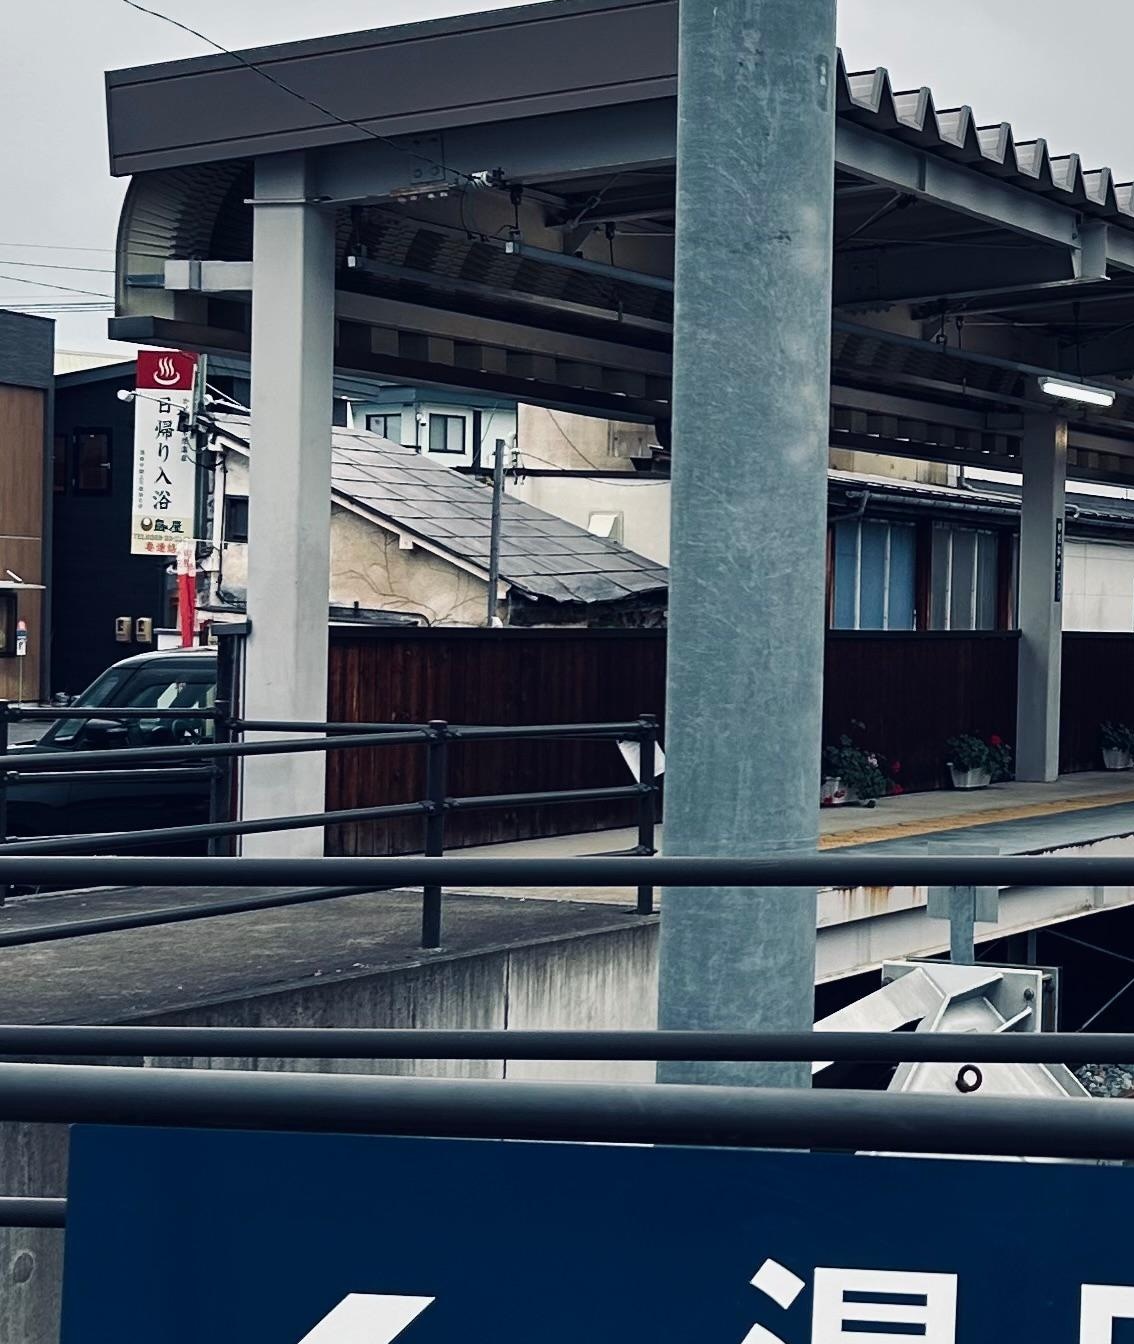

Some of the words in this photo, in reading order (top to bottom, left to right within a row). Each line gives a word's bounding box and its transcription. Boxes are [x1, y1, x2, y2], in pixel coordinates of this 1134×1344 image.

[153, 397, 174, 510] 日帰り入浴
